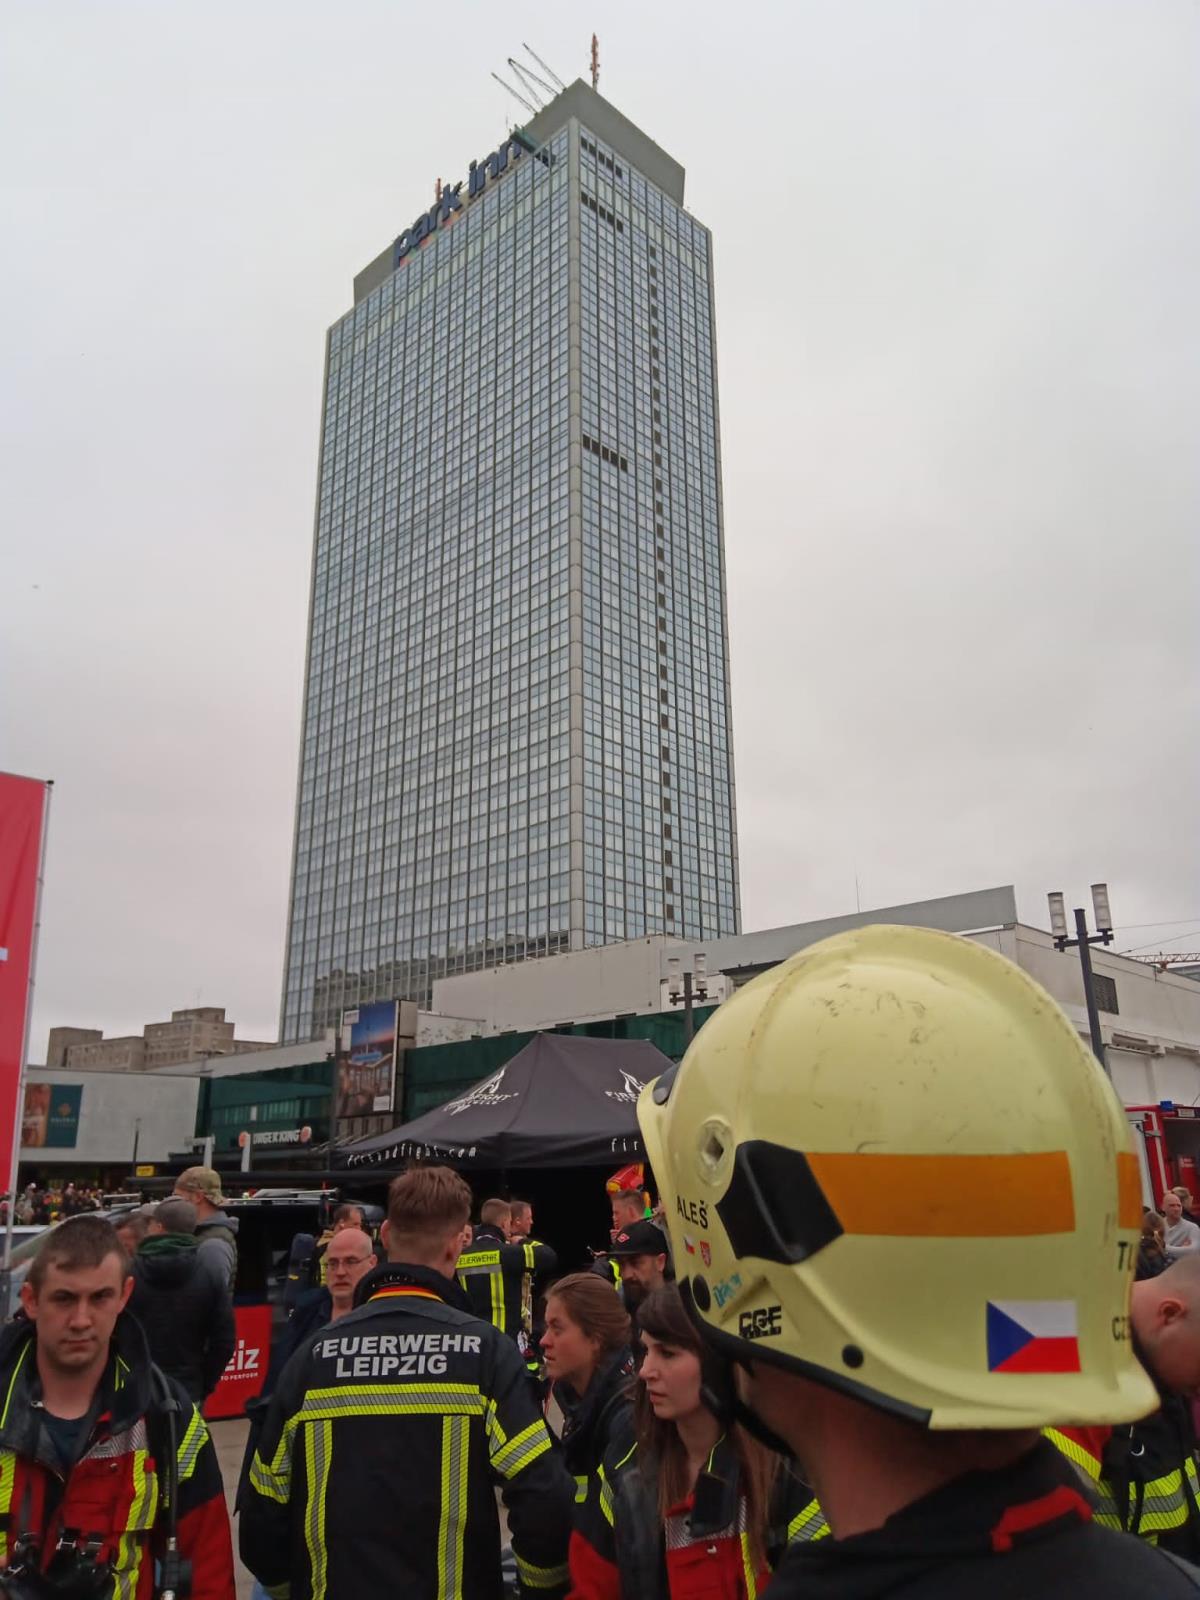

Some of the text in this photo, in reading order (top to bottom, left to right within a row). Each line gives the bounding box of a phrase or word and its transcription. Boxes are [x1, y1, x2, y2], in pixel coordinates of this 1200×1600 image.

[393, 138, 522, 270] park inn
[676, 1194, 709, 1230] ALEŠ
[457, 1252, 498, 1265] EUERWEHR
[335, 1353, 448, 1379] LEIPZIG
